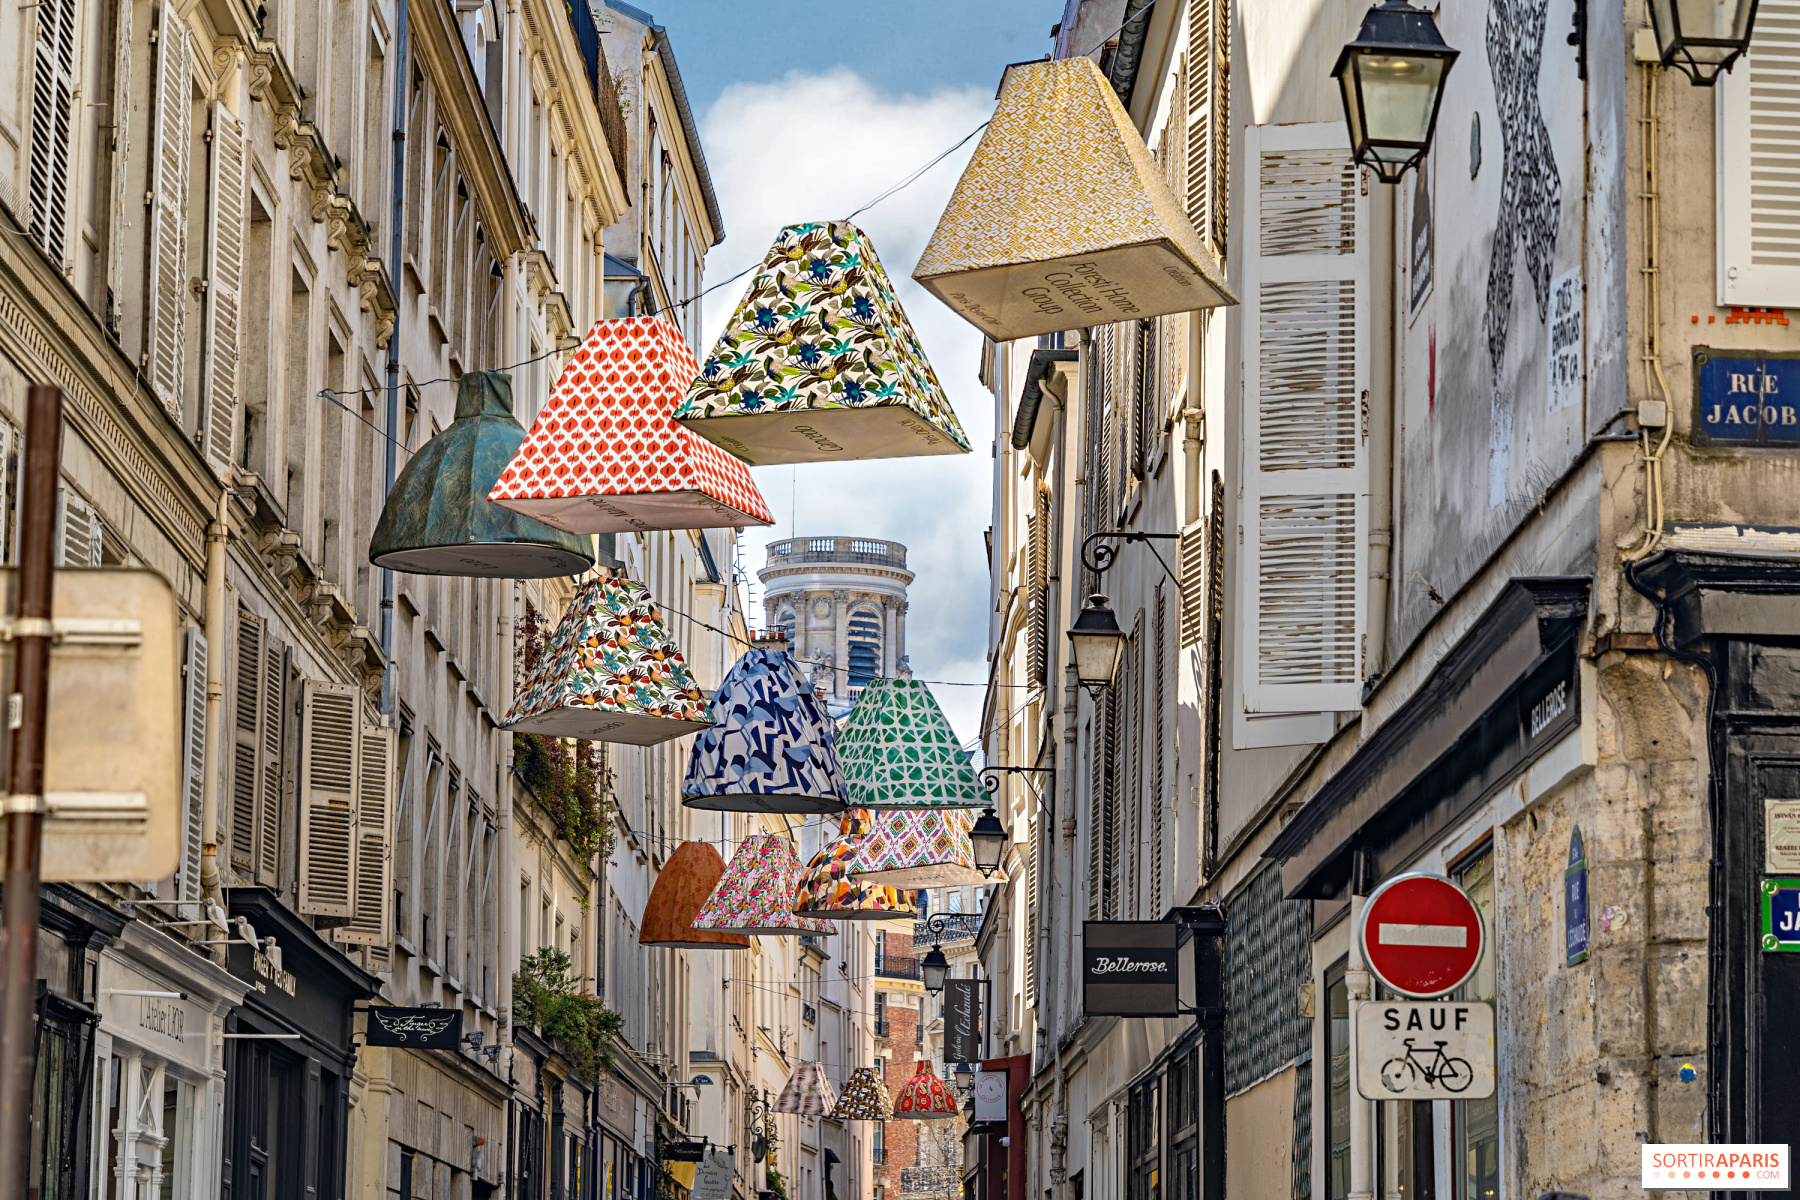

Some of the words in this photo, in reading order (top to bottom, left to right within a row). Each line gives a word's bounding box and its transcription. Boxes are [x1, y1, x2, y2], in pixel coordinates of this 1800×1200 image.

[1021, 286, 1064, 315] Group
[1044, 272, 1103, 314] Collection
[1069, 261, 1120, 289] Foresti
[1098, 287, 1141, 314] Home
[1727, 372, 1779, 395] RUE
[1706, 404, 1798, 426] JACOB
[1531, 679, 1566, 739] BELLEROSE
[1571, 880, 1580, 903] RUE
[1091, 957, 1168, 975] Bellerose.
[1383, 1007, 1469, 1031] SAUF
[951, 1033, 968, 1063] Galerie
